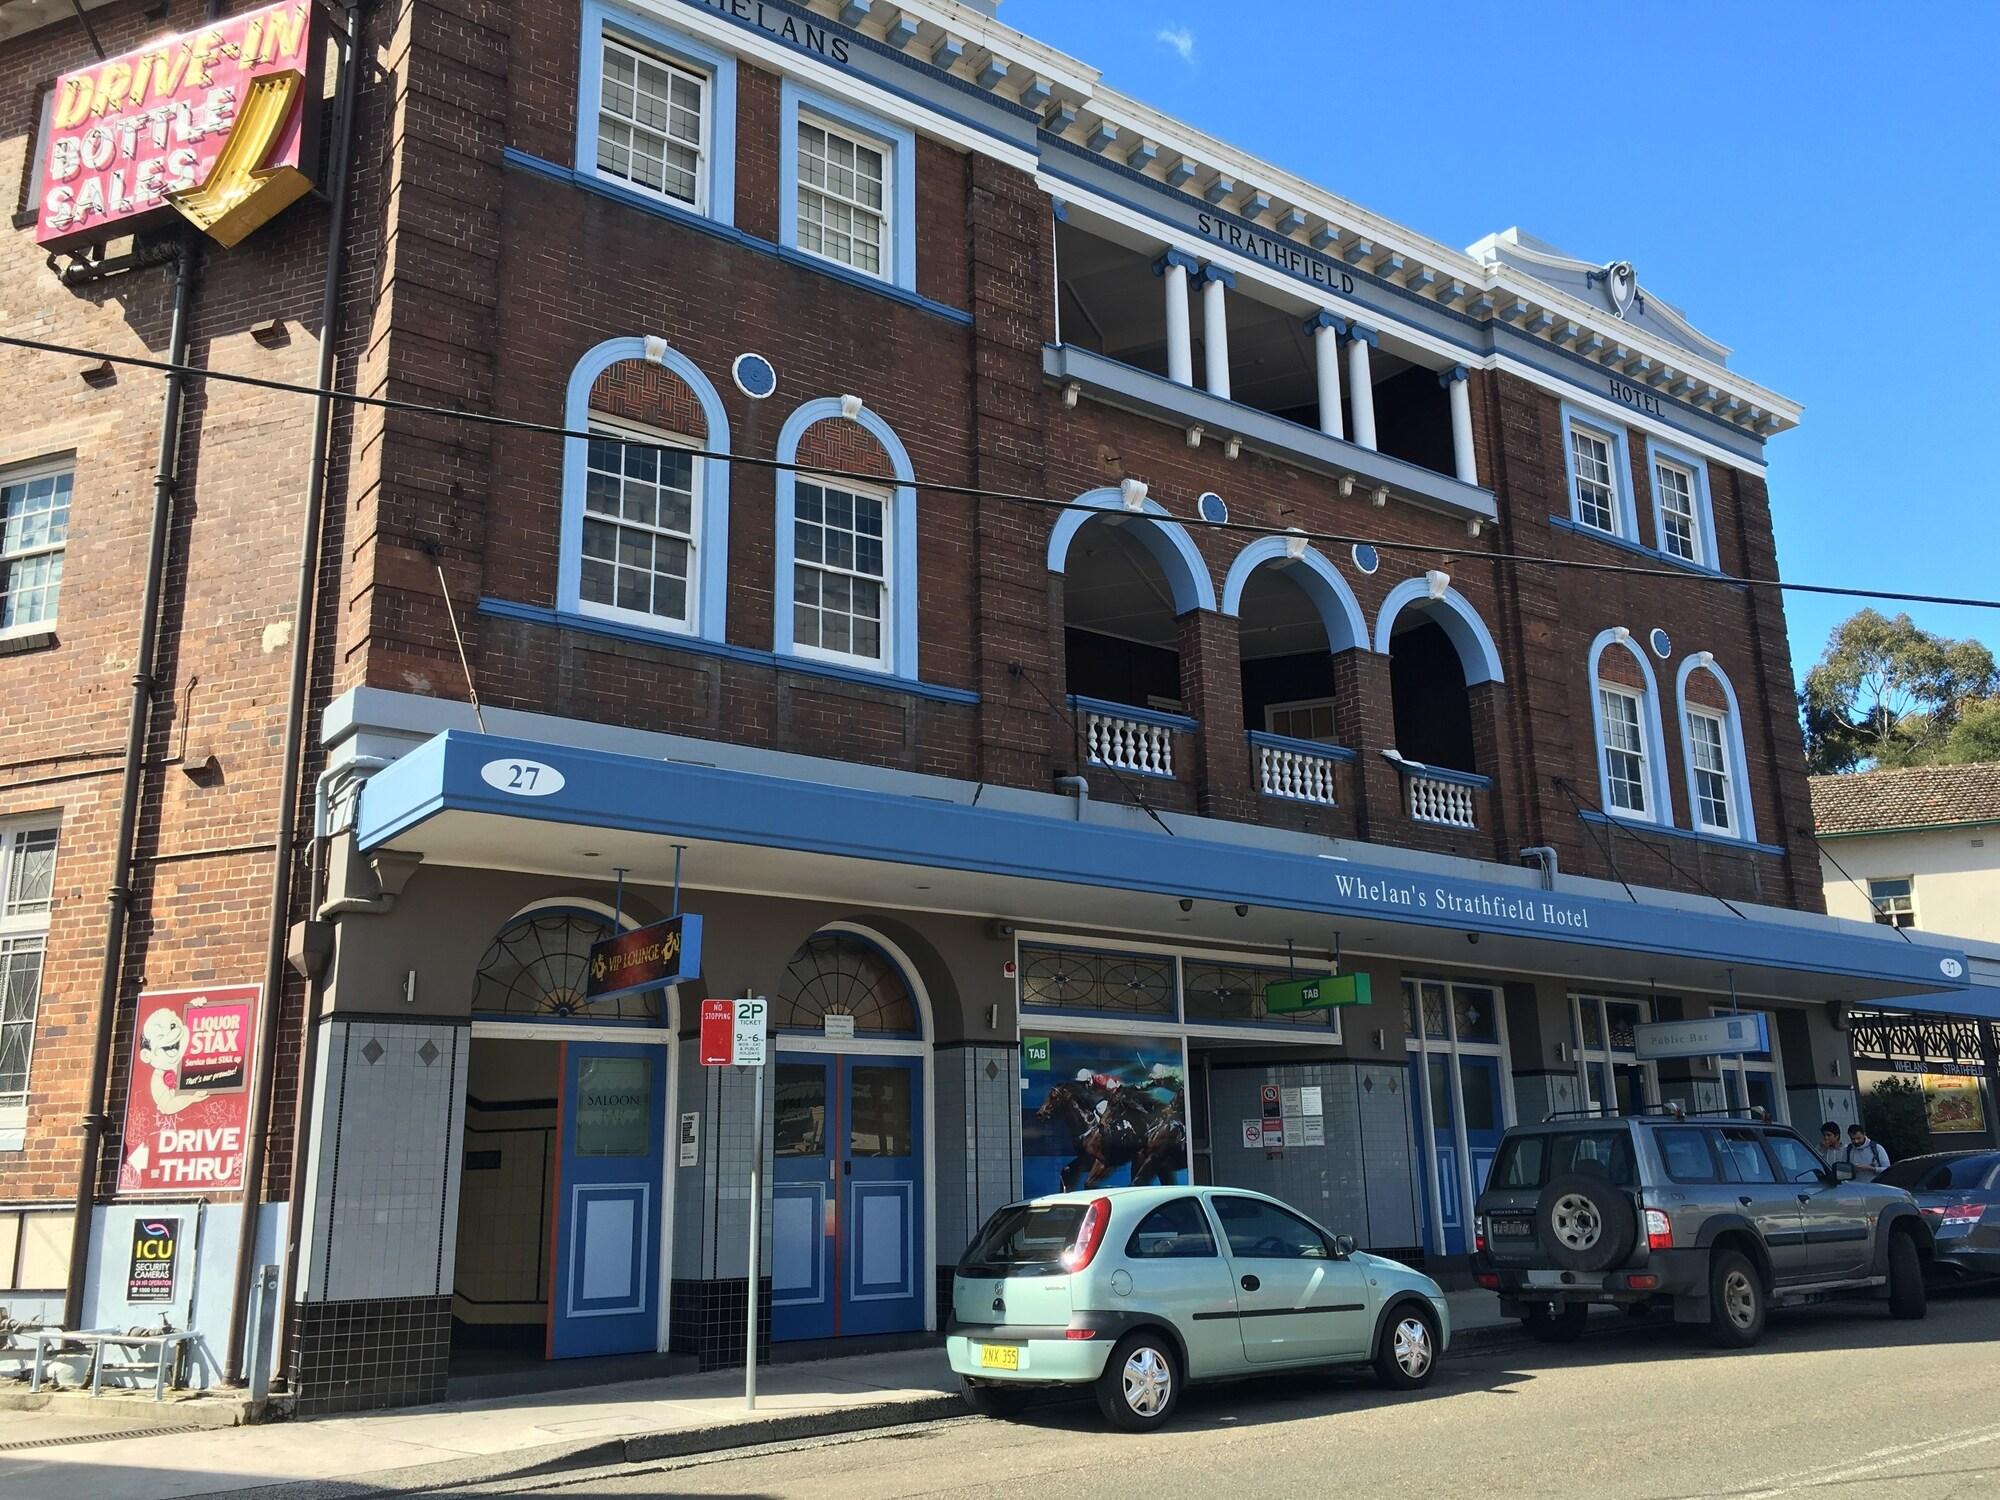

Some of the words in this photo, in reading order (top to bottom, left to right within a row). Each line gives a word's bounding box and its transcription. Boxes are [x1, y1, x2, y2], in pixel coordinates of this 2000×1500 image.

[54, 5, 308, 129] DRIVE-IN
[51, 86, 236, 183] BOTTLE
[45, 148, 198, 230] SALES
[1197, 214, 1354, 295] STRATHFIELD
[1609, 378, 1665, 418] HOTEL
[507, 764, 540, 790] 27
[1335, 874, 1426, 907] Whelan's
[1436, 888, 1535, 922] Strathfield
[1542, 903, 1589, 928] Hotel
[608, 954, 622, 972] VIP
[623, 943, 660, 969] LOUNGE
[1302, 988, 1319, 999] TAB
[713, 1003, 723, 1011] NO
[738, 1003, 763, 1019] 2P
[192, 1015, 241, 1032] LIQUOR
[704, 1012, 730, 1020] STOPPING
[190, 1029, 240, 1055] STAX
[1651, 1033, 1685, 1046] Public
[1689, 1033, 1709, 1043] Bar
[1028, 1048, 1046, 1059] TAB
[1894, 1060, 1929, 1073] WHELANS
[1943, 1063, 1984, 1076] STRATHFIELD
[587, 1095, 640, 1106] SALOON
[157, 1126, 241, 1153] DRIVE
[136, 1239, 173, 1259] ICU
[134, 1270, 170, 1279] CAMERAS
[135, 1262, 170, 1271] SECURITY
[983, 1347, 999, 1362] XNX
